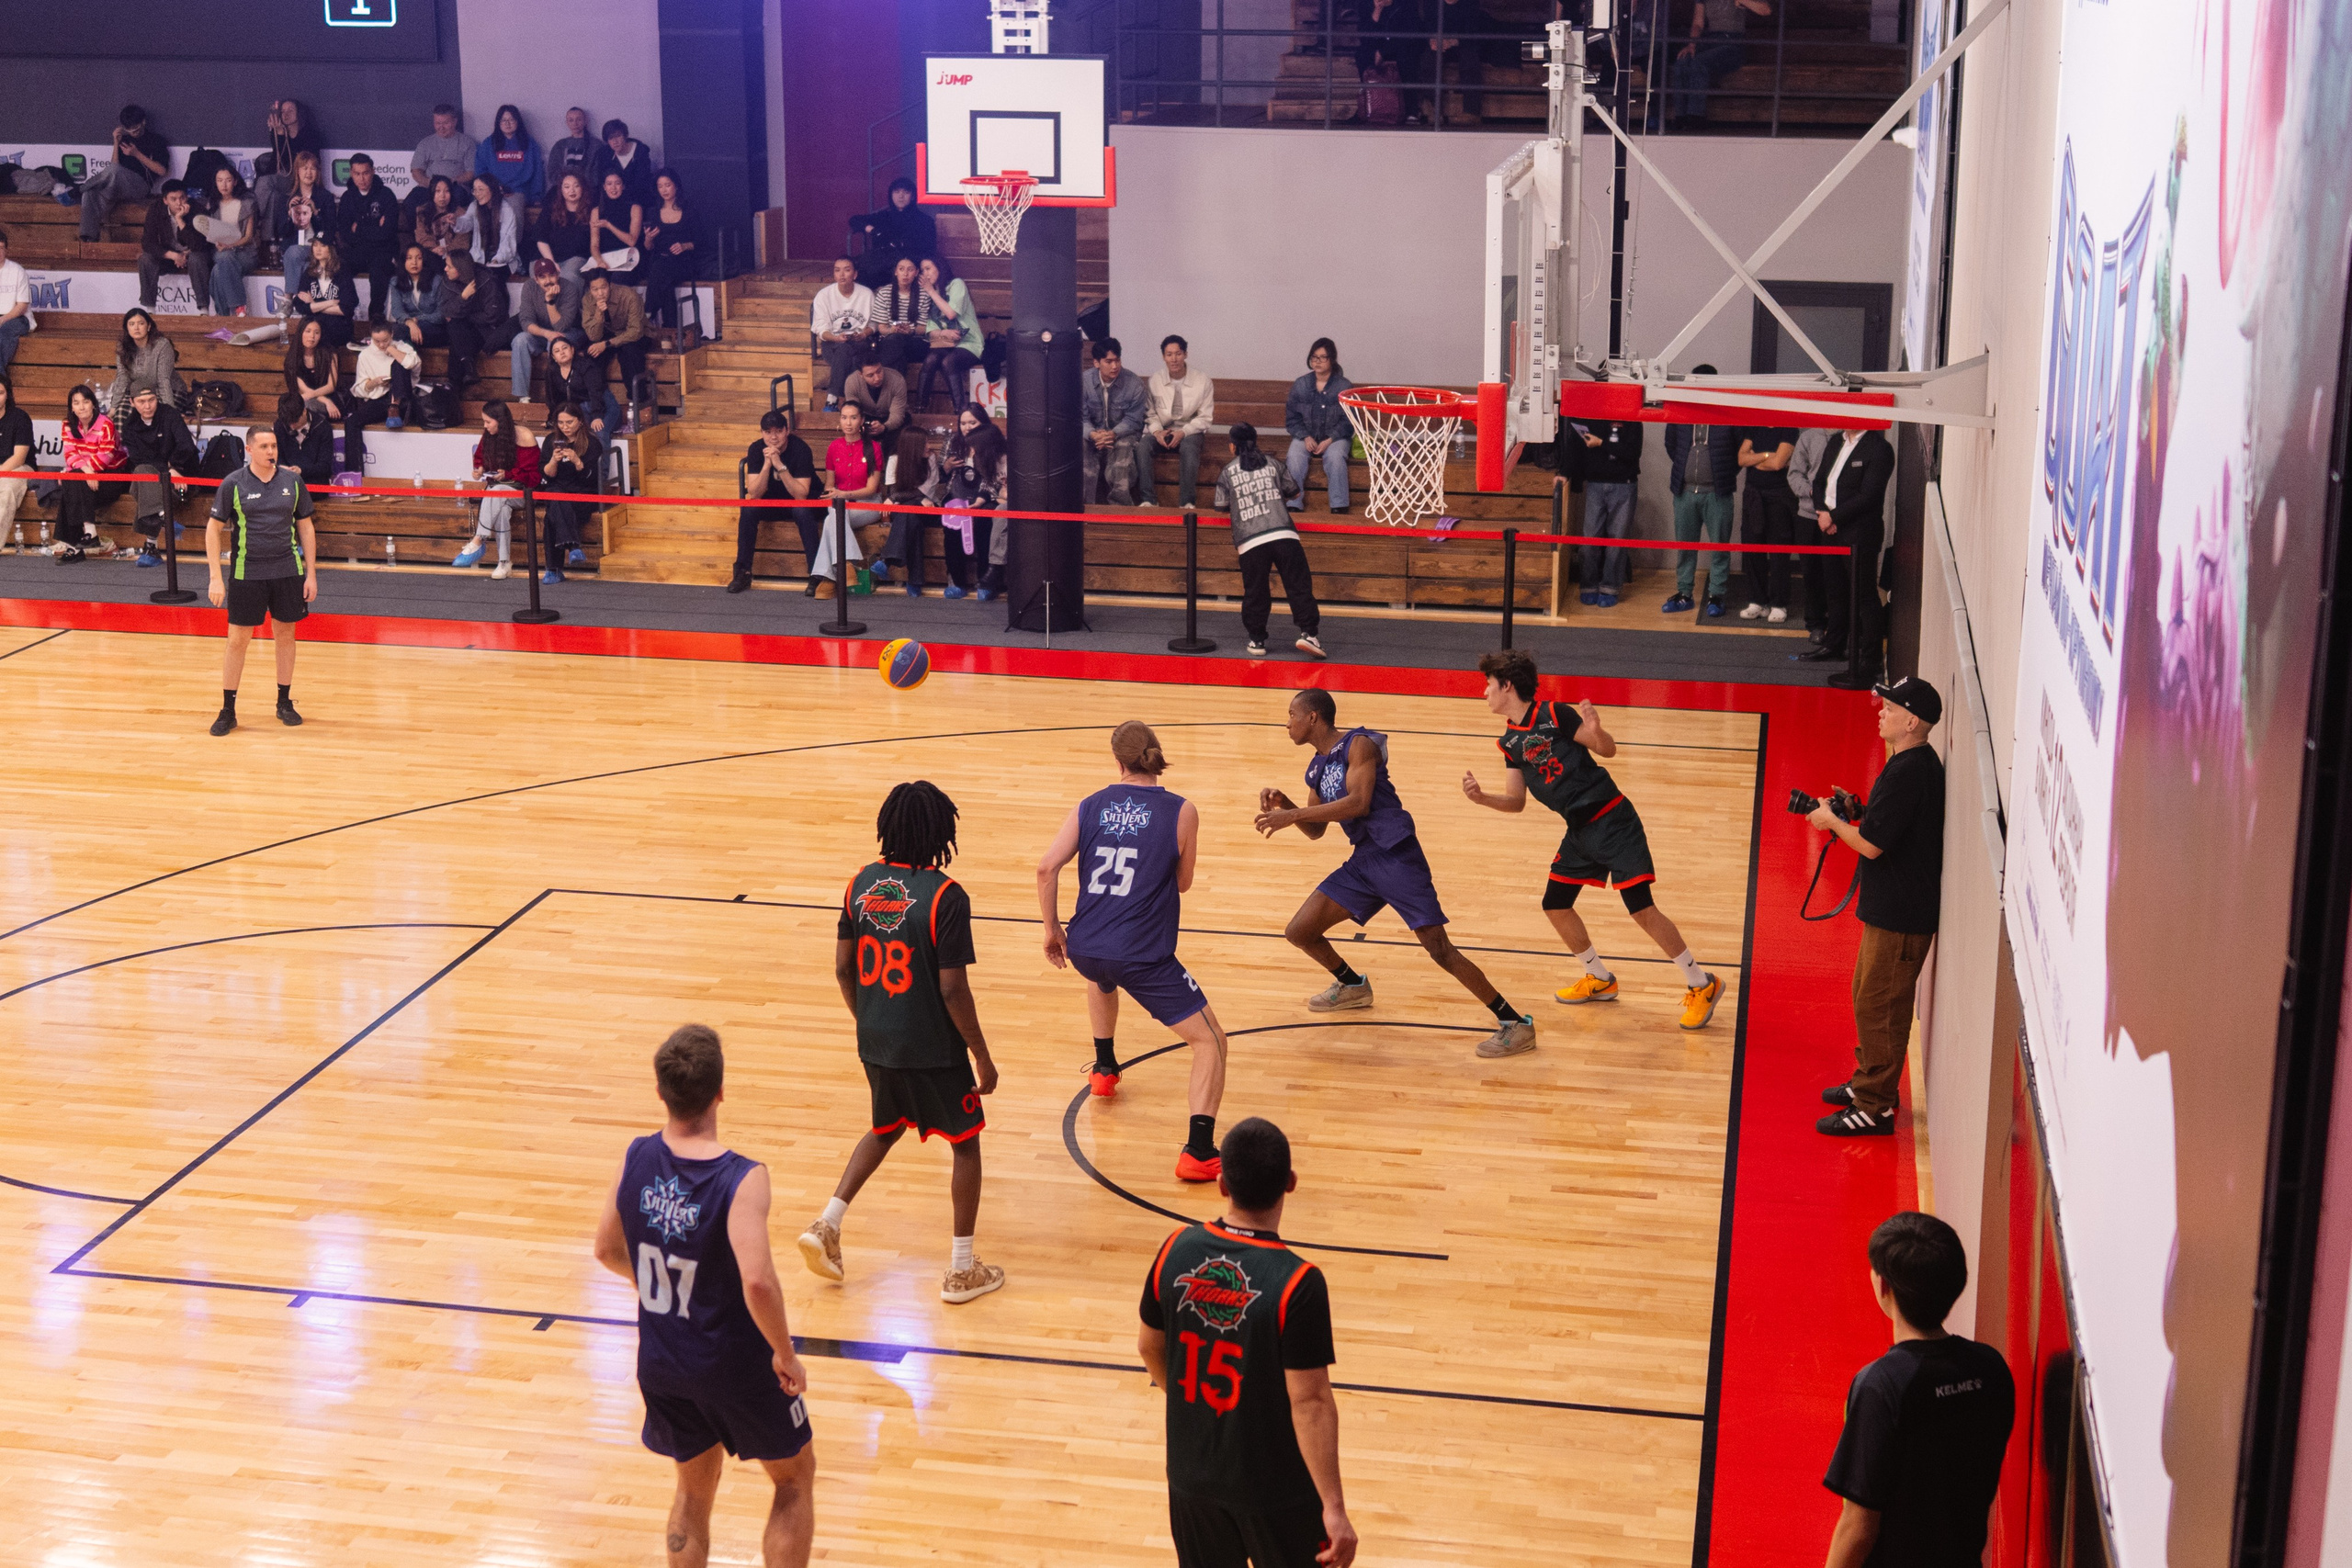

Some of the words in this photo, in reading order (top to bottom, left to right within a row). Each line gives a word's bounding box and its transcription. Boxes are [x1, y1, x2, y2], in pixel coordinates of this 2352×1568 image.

[90, 158, 110, 168] Free
[373, 165, 406, 174] eedom
[383, 175, 410, 186] erApp
[1231, 471, 1250, 487] BIG
[1252, 466, 1276, 479] AND
[1234, 478, 1272, 499] FOCUS
[1238, 495, 1254, 509] ON
[1256, 489, 1281, 502] THE
[1239, 503, 1270, 522] GOAL
[1539, 757, 1564, 784] 23
[1102, 809, 1149, 826] SHIVERS
[1088, 846, 1138, 897] 25
[856, 934, 915, 998] 08
[1182, 973, 1199, 992] 2
[642, 1189, 698, 1227] SHIVERS
[637, 1242, 698, 1320] 07
[1178, 1331, 1244, 1417] 15
[1935, 1380, 1974, 1397] KELME
